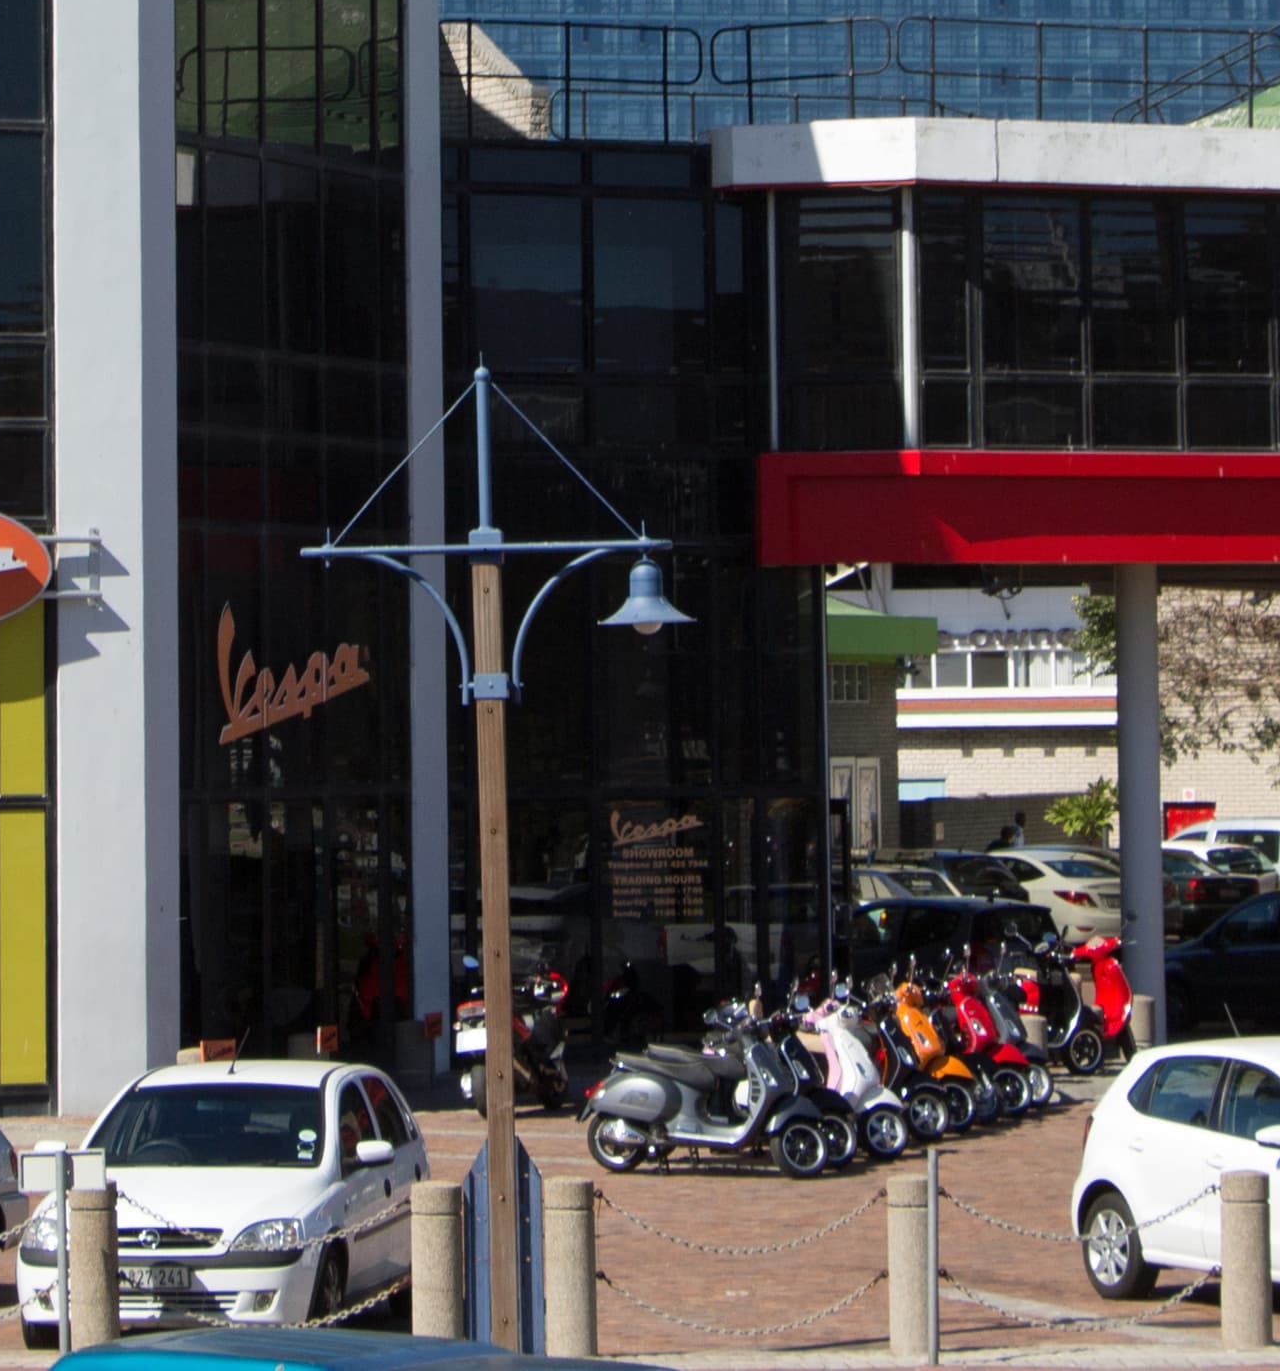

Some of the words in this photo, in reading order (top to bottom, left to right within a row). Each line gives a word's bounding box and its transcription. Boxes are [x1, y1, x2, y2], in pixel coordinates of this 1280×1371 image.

[217, 600, 370, 745] Vespa
[609, 810, 705, 847] Vespa
[623, 847, 694, 858] SHOWROOM
[614, 875, 661, 884] TRADING
[664, 875, 701, 884] HOURS
